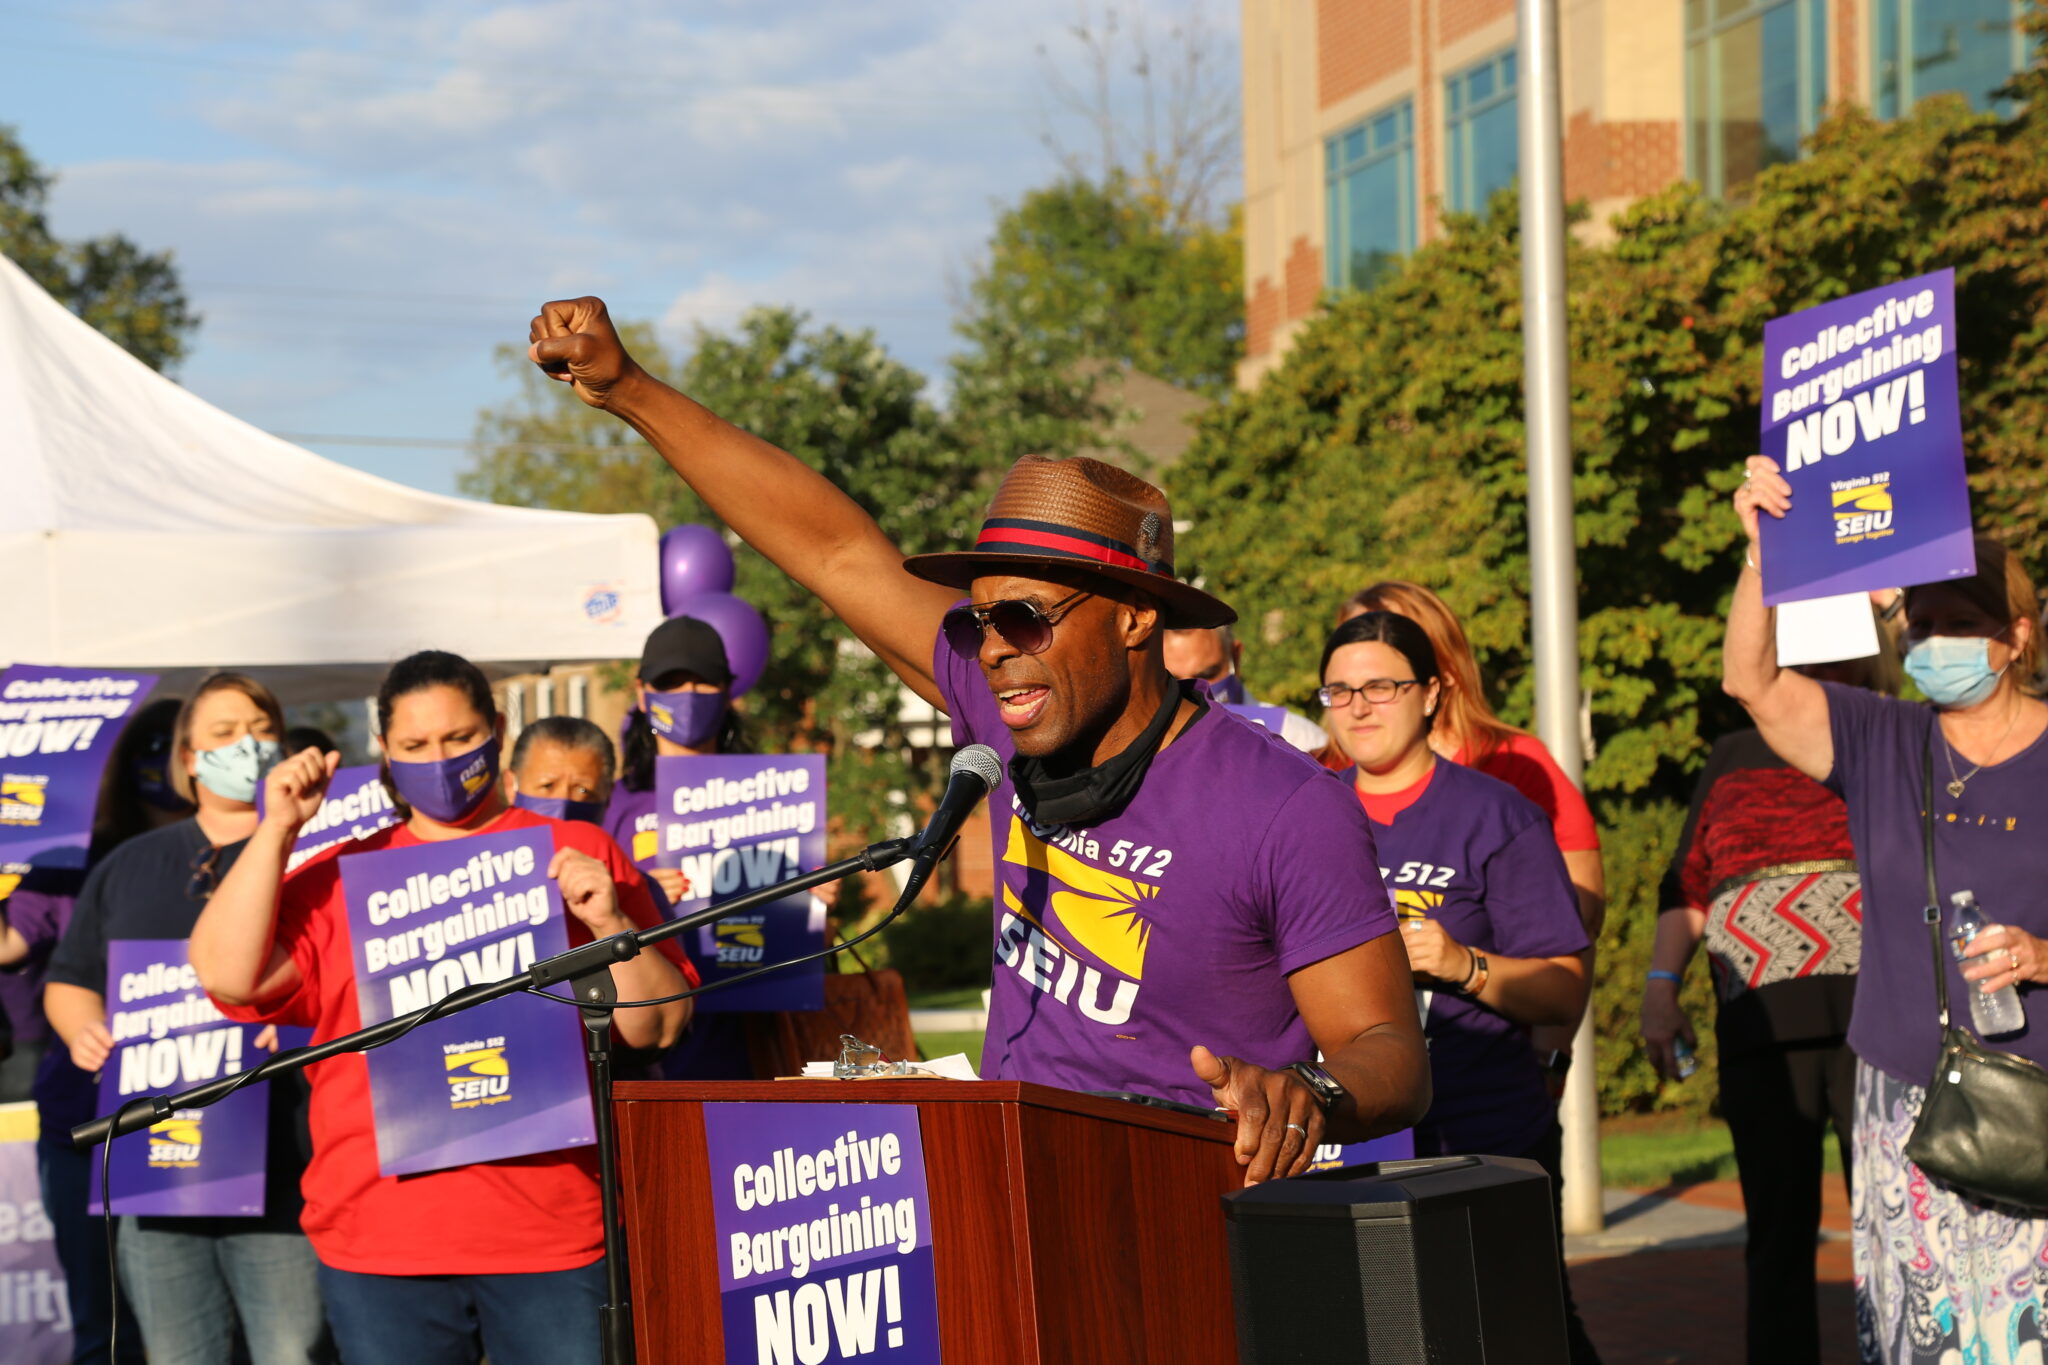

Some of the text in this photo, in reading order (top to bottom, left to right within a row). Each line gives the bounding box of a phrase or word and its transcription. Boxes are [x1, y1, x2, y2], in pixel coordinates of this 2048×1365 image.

[1772, 323, 1943, 423] Bargaining
[1781, 289, 1935, 380] Collective
[1786, 369, 1926, 473] NOW!
[1835, 510, 1893, 538] SEIU
[666, 801, 816, 853] Bargaining
[673, 767, 810, 816] Collective
[367, 845, 536, 926] Collective
[680, 836, 800, 901] NOW!
[1108, 839, 1173, 878] 512
[1394, 861, 1456, 888] 512
[364, 885, 550, 974] Bargaining
[996, 912, 1140, 1026] SEIU
[118, 1025, 243, 1096] NOW!
[450, 1076, 510, 1102] SEIU
[733, 1130, 902, 1212] Collective
[730, 1195, 918, 1280] Bargaining
[754, 1264, 904, 1365] NOW!
